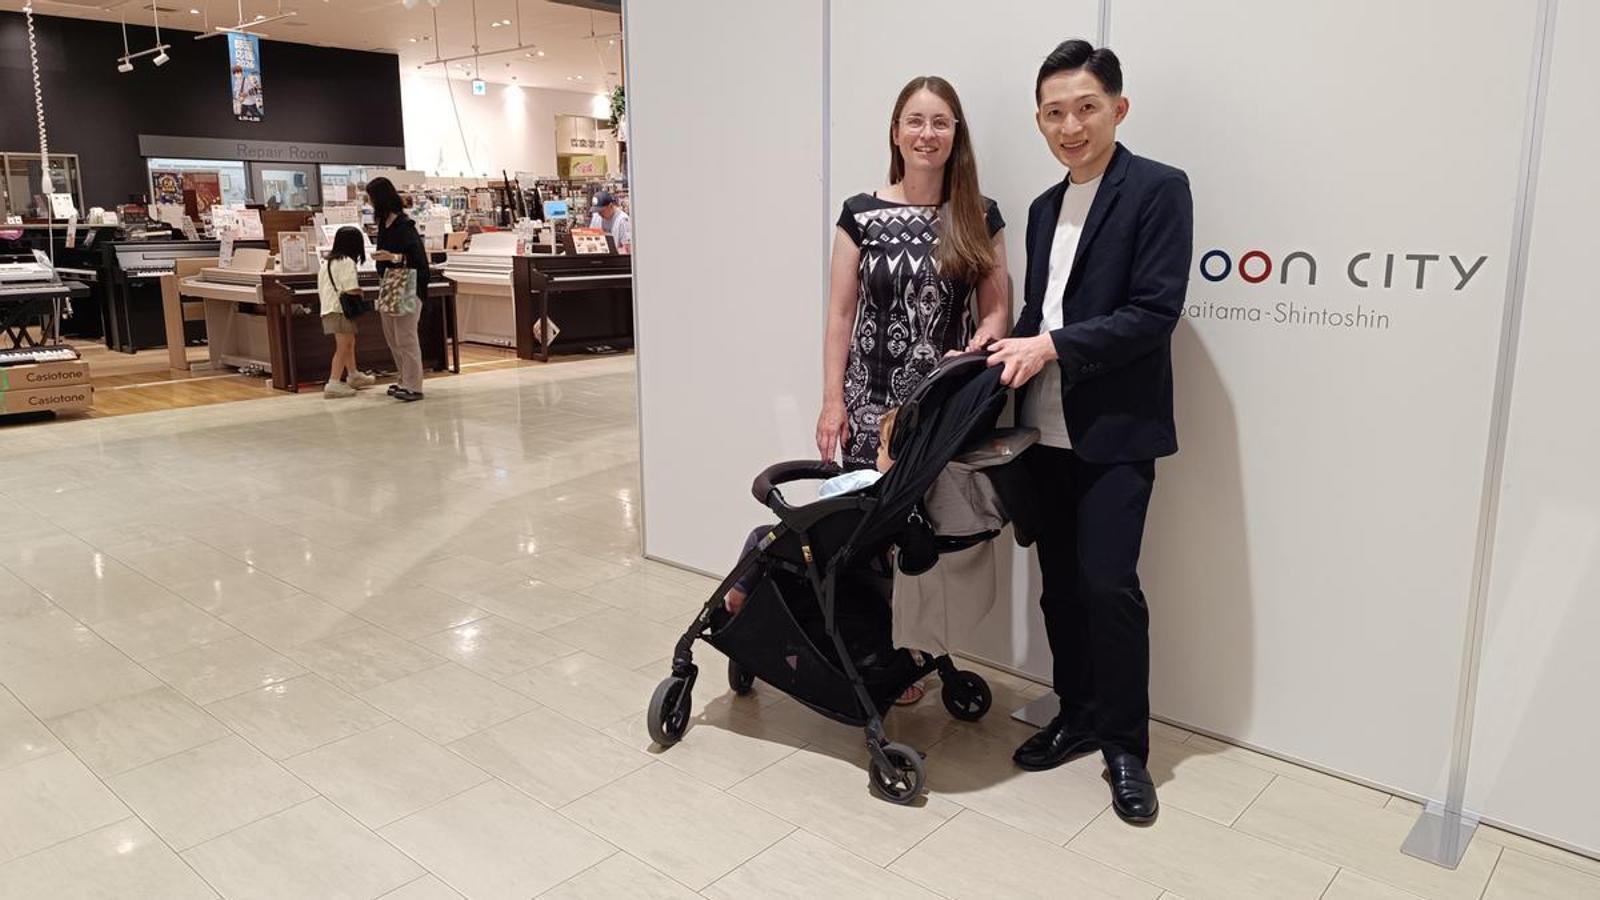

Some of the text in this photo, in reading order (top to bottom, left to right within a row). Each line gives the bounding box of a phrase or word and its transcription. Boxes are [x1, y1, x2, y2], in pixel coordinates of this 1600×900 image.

[236, 144, 329, 159] Repair Room
[1347, 252, 1489, 290] CITY
[26, 370, 83, 383] Casiotone
[28, 394, 86, 406] Casiotone
